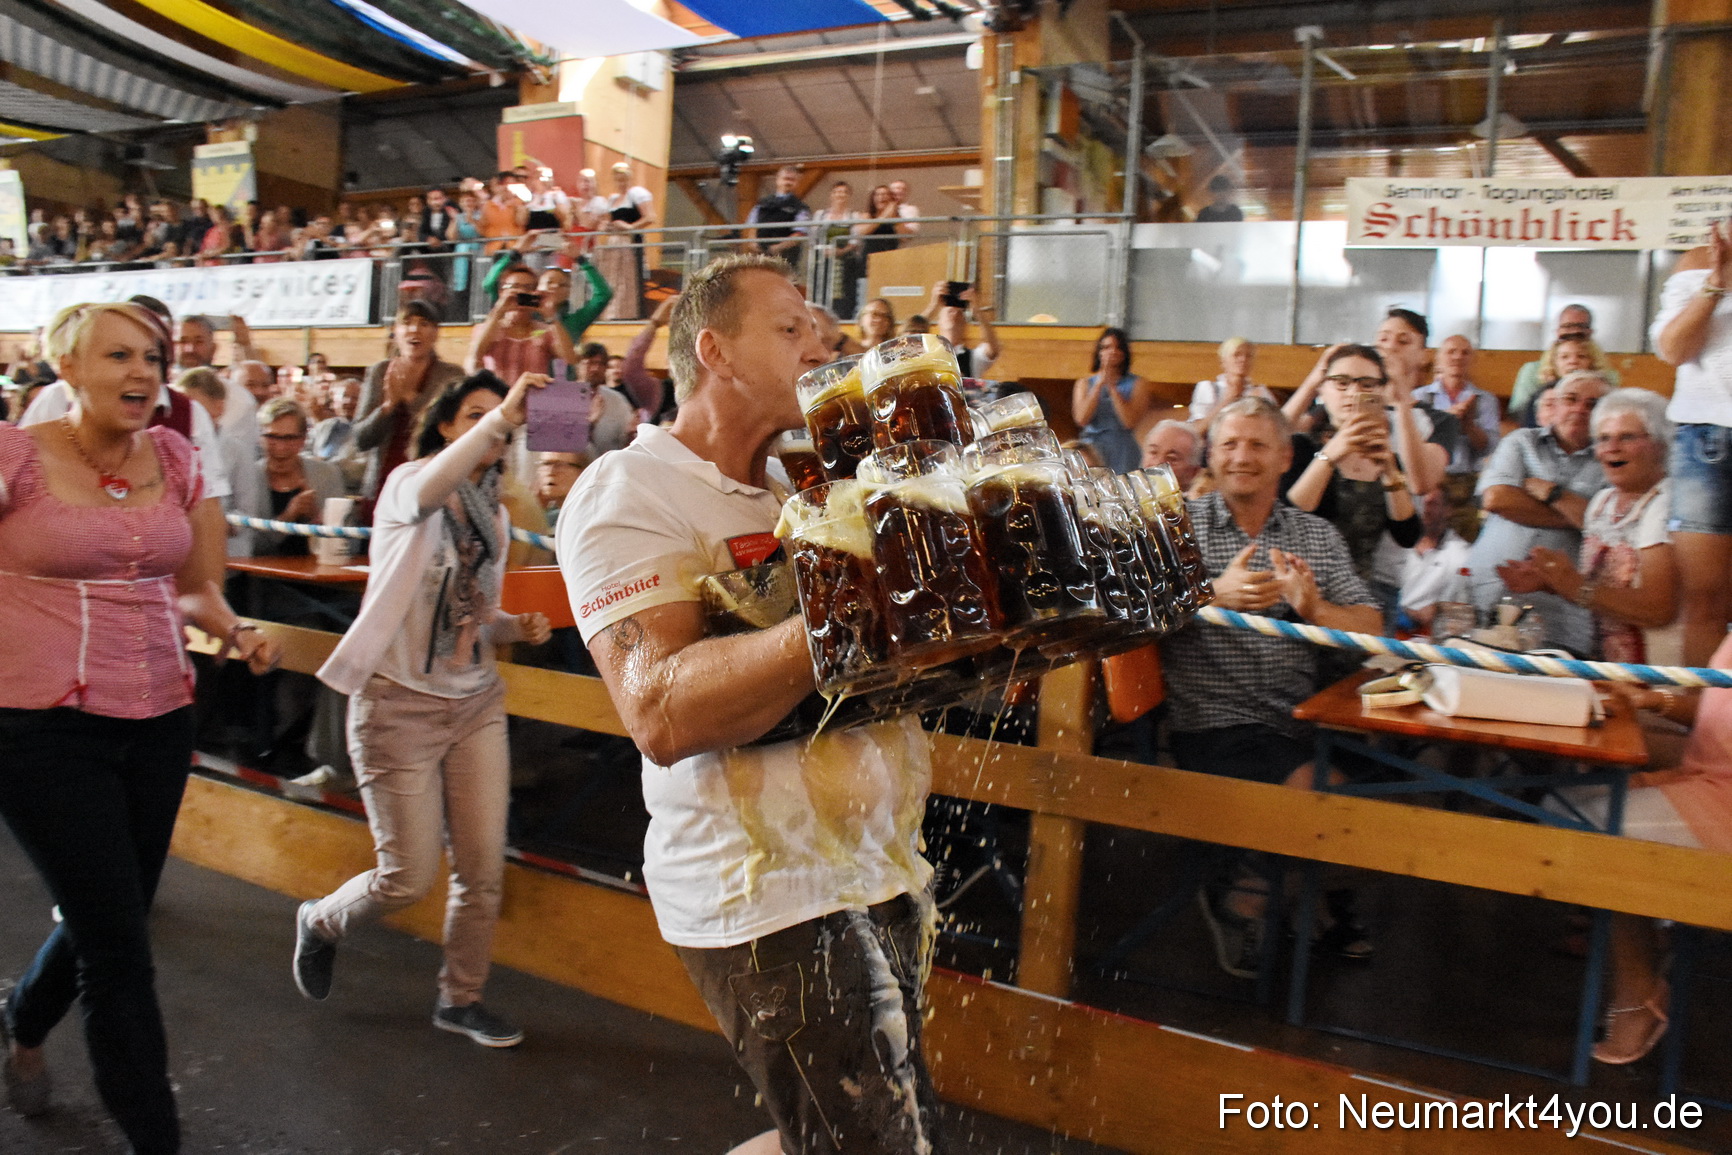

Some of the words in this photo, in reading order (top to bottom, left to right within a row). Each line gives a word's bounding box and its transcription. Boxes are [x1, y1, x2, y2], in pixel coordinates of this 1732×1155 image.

[1384, 184, 1464, 200] Seminar
[1481, 184, 1616, 204] Tagungshotel
[1361, 202, 1638, 242] Schönblick
[233, 271, 357, 299] services
[580, 574, 661, 618] Schönblick
[601, 581, 621, 592] Hotel
